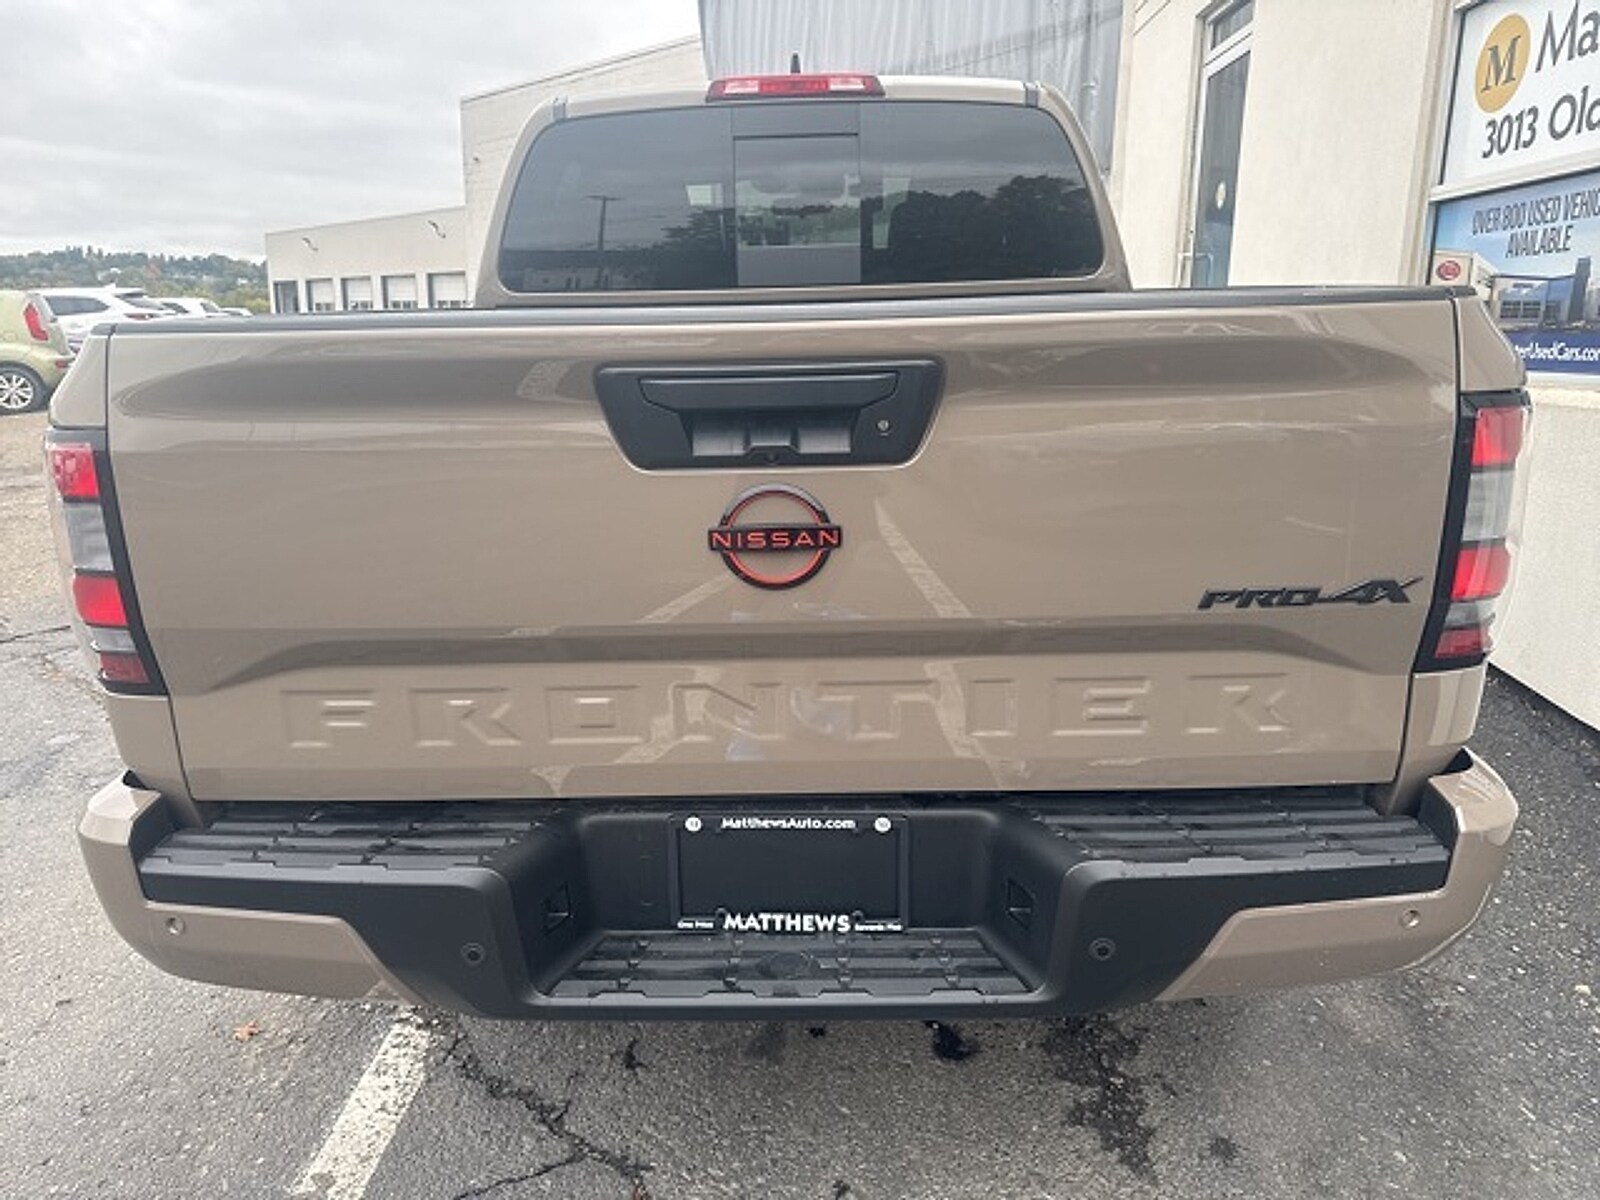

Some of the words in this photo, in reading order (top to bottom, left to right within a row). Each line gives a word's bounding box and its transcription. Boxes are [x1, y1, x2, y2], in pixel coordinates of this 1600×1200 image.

[1480, 35, 1522, 93] M
[1482, 105, 1539, 159] 3013
[1472, 207, 1501, 236] OVER
[1527, 195, 1562, 226] USED
[1505, 225, 1574, 259] AVAILABLE
[712, 530, 839, 549] NISSAN
[280, 673, 1292, 749] FRONTIER
[721, 816, 856, 830] MatthewsAuto.com
[722, 912, 850, 932] MATTHEWS
